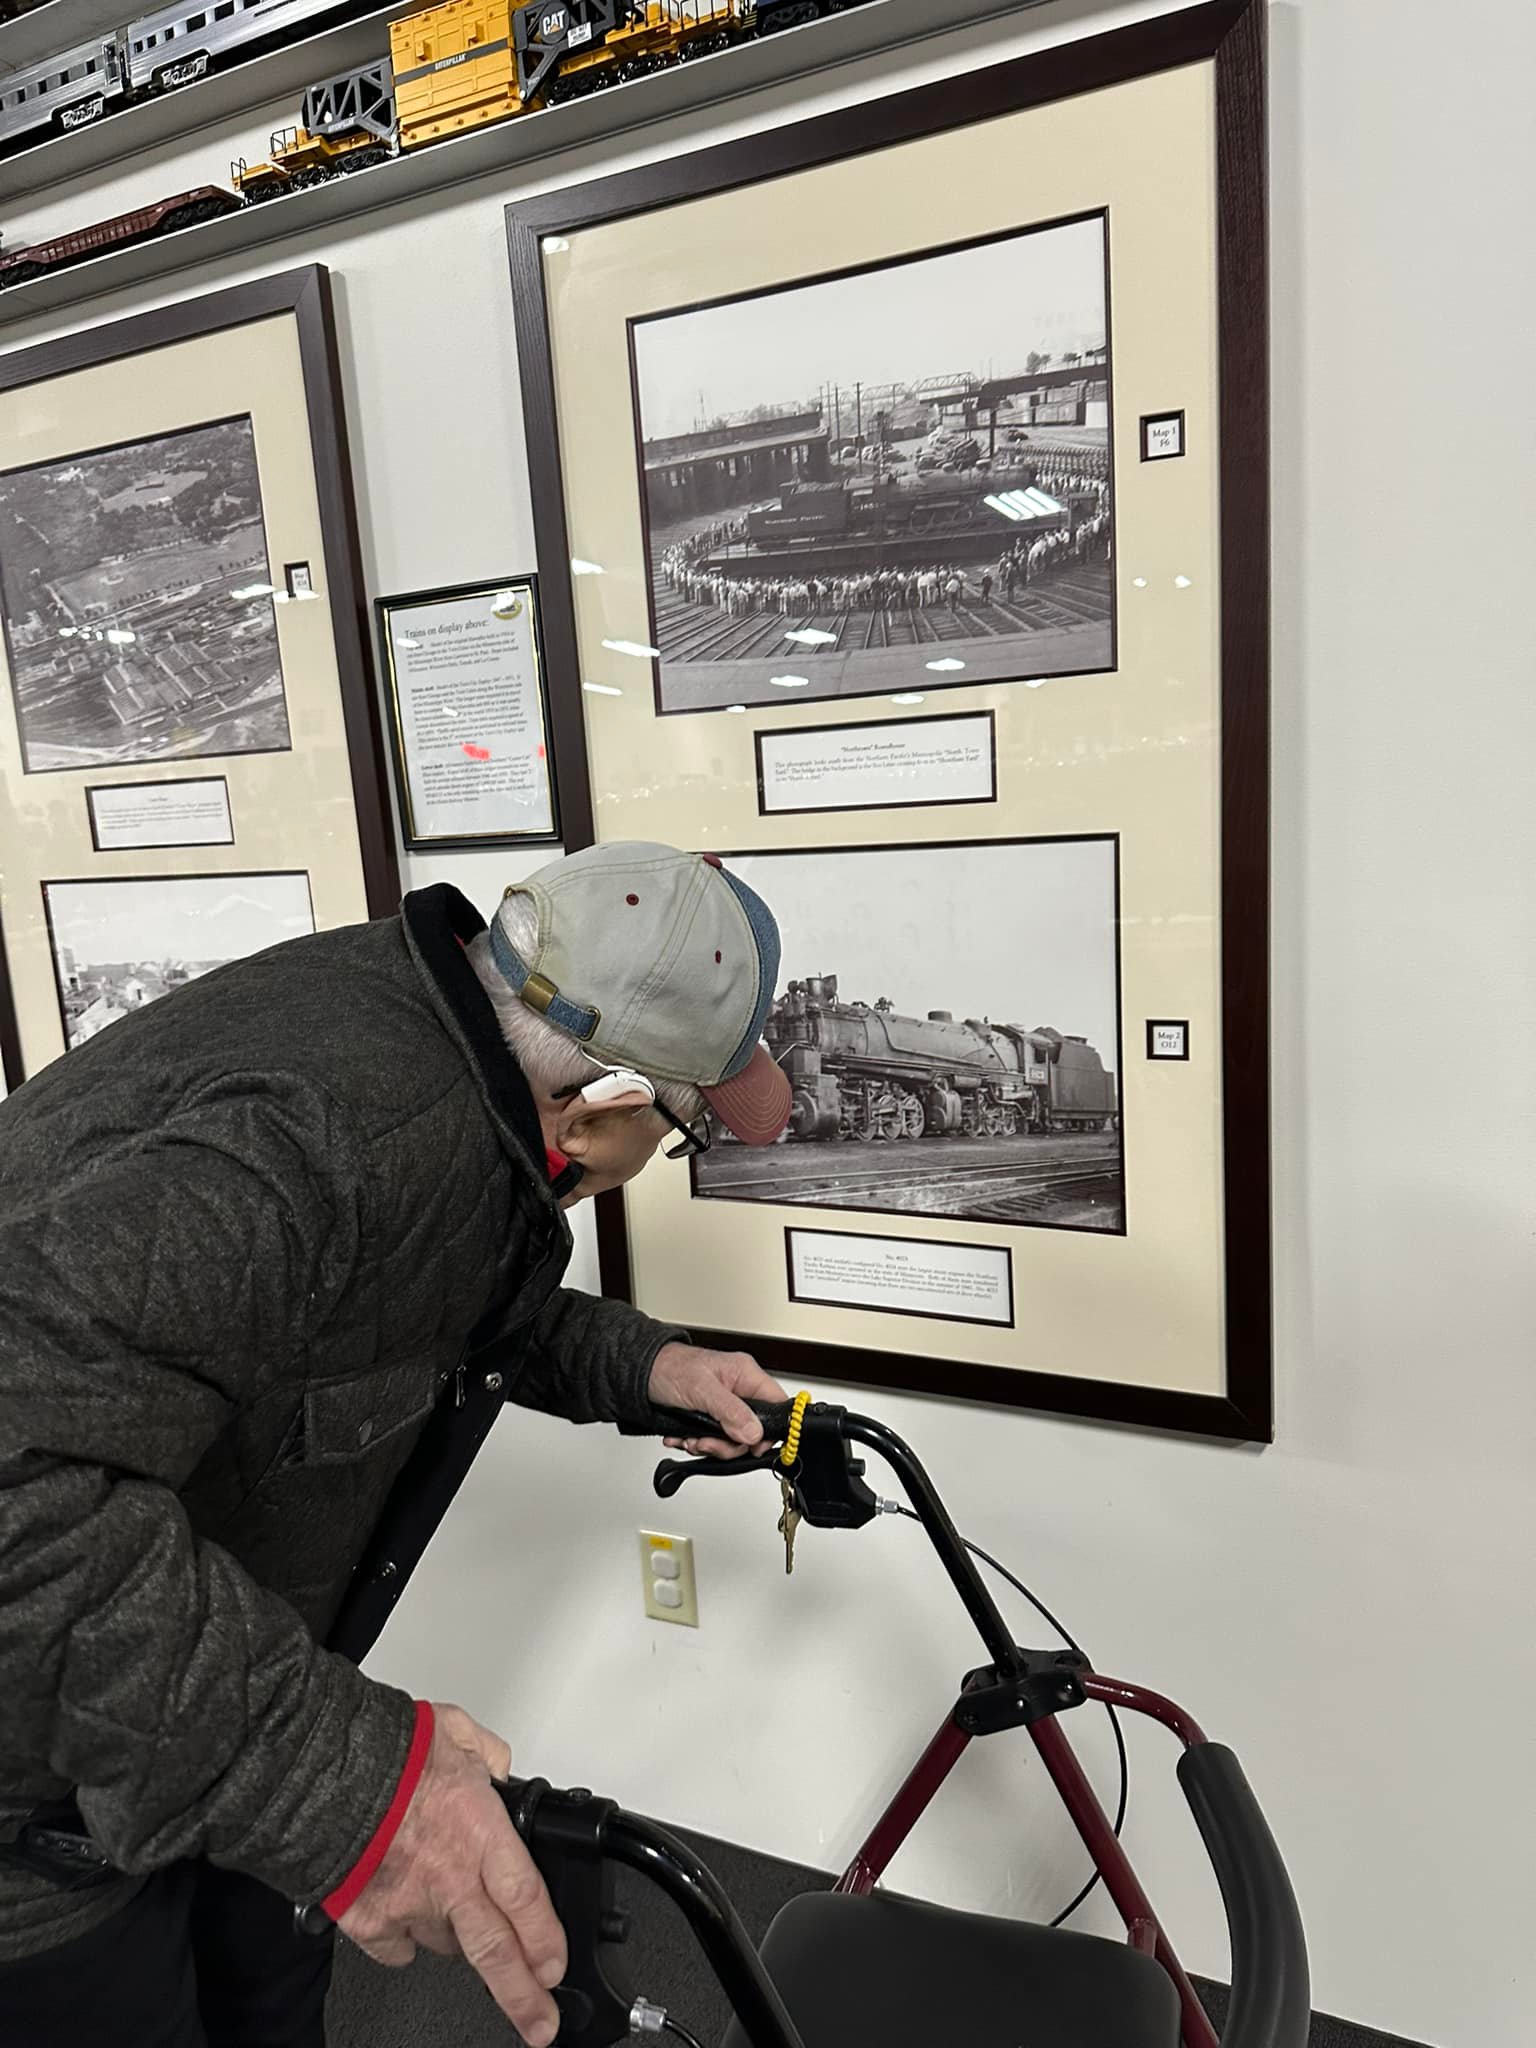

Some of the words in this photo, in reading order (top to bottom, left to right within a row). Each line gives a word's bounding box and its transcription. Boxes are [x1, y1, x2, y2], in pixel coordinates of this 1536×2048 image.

[543, 9, 566, 36] CAT
[405, 628, 427, 639] Trains
[427, 627, 437, 636] on
[438, 622, 464, 635] display
[465, 619, 489, 630] above:
[1158, 1031, 1174, 1040] Map
